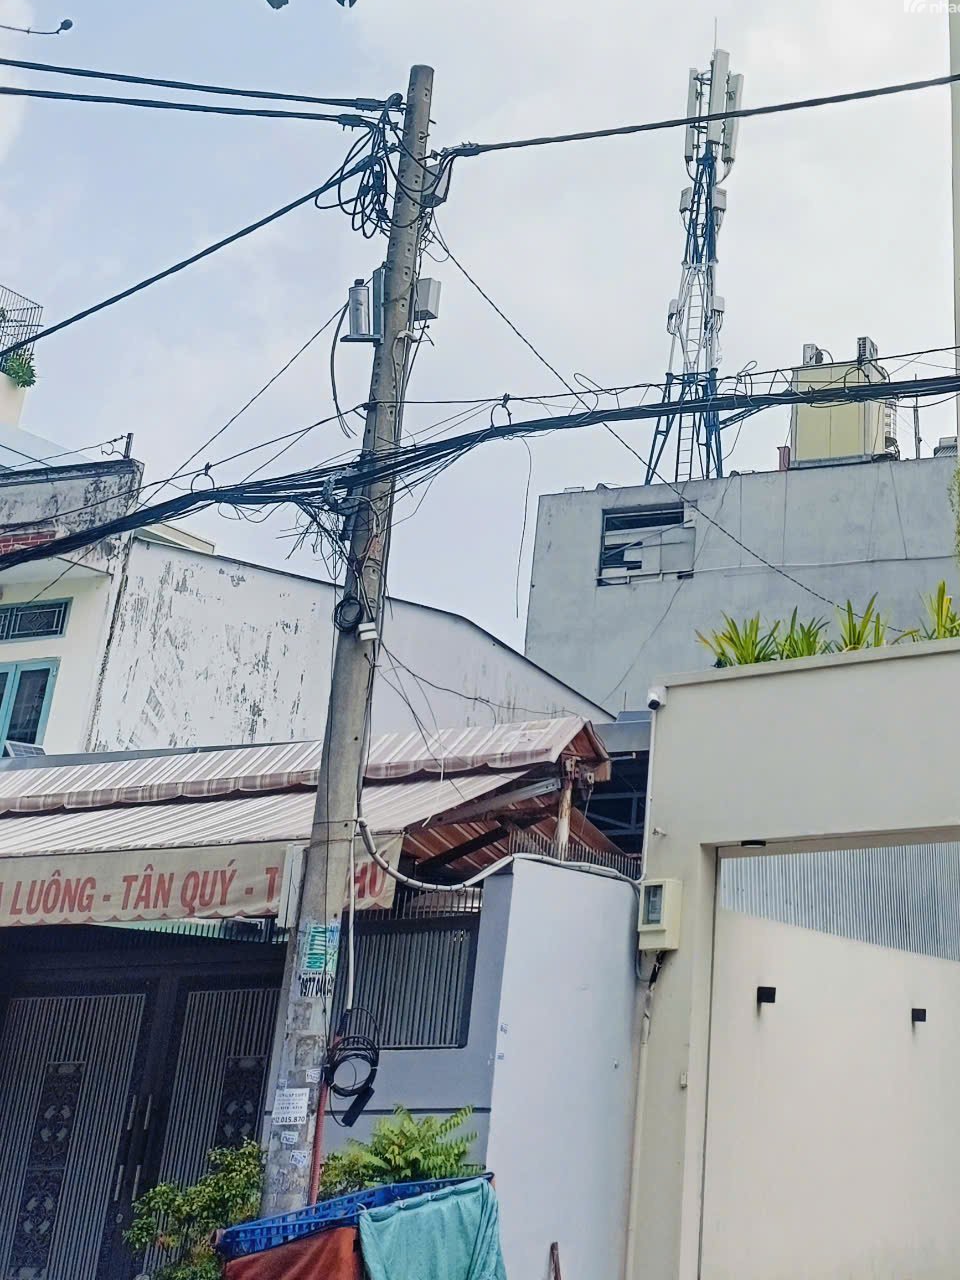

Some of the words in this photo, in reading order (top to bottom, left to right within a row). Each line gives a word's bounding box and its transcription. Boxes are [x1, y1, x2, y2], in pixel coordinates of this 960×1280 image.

[9, 869, 97, 915] LUÔNG
[121, 863, 175, 910] TÂN
[180, 858, 237, 916] QUÝ
